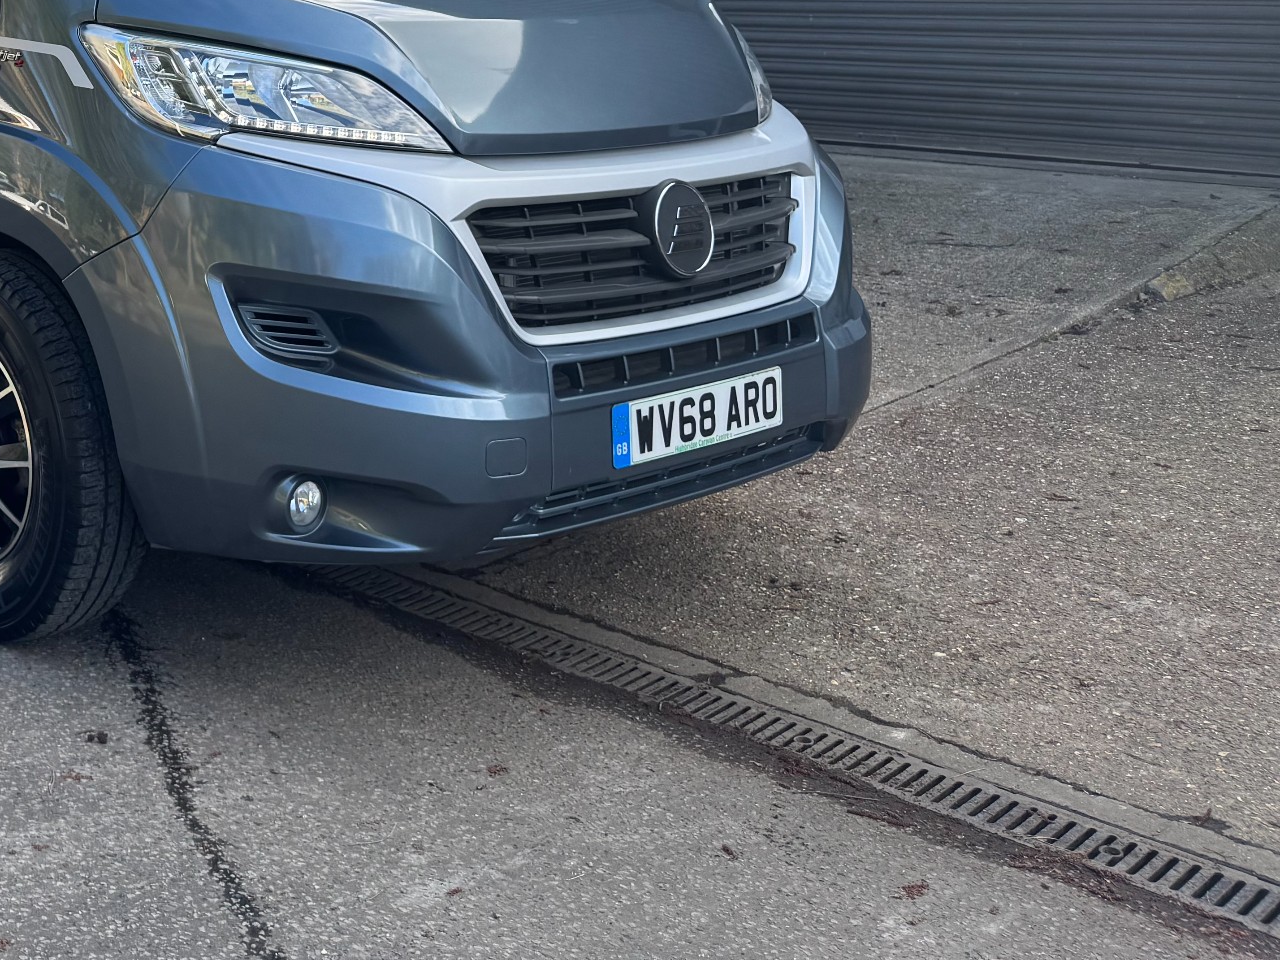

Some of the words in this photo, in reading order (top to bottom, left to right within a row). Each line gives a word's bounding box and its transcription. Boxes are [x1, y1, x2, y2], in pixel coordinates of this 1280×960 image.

[635, 391, 717, 455] WV68
[726, 376, 779, 432] ARO
[616, 442, 629, 456] GB
